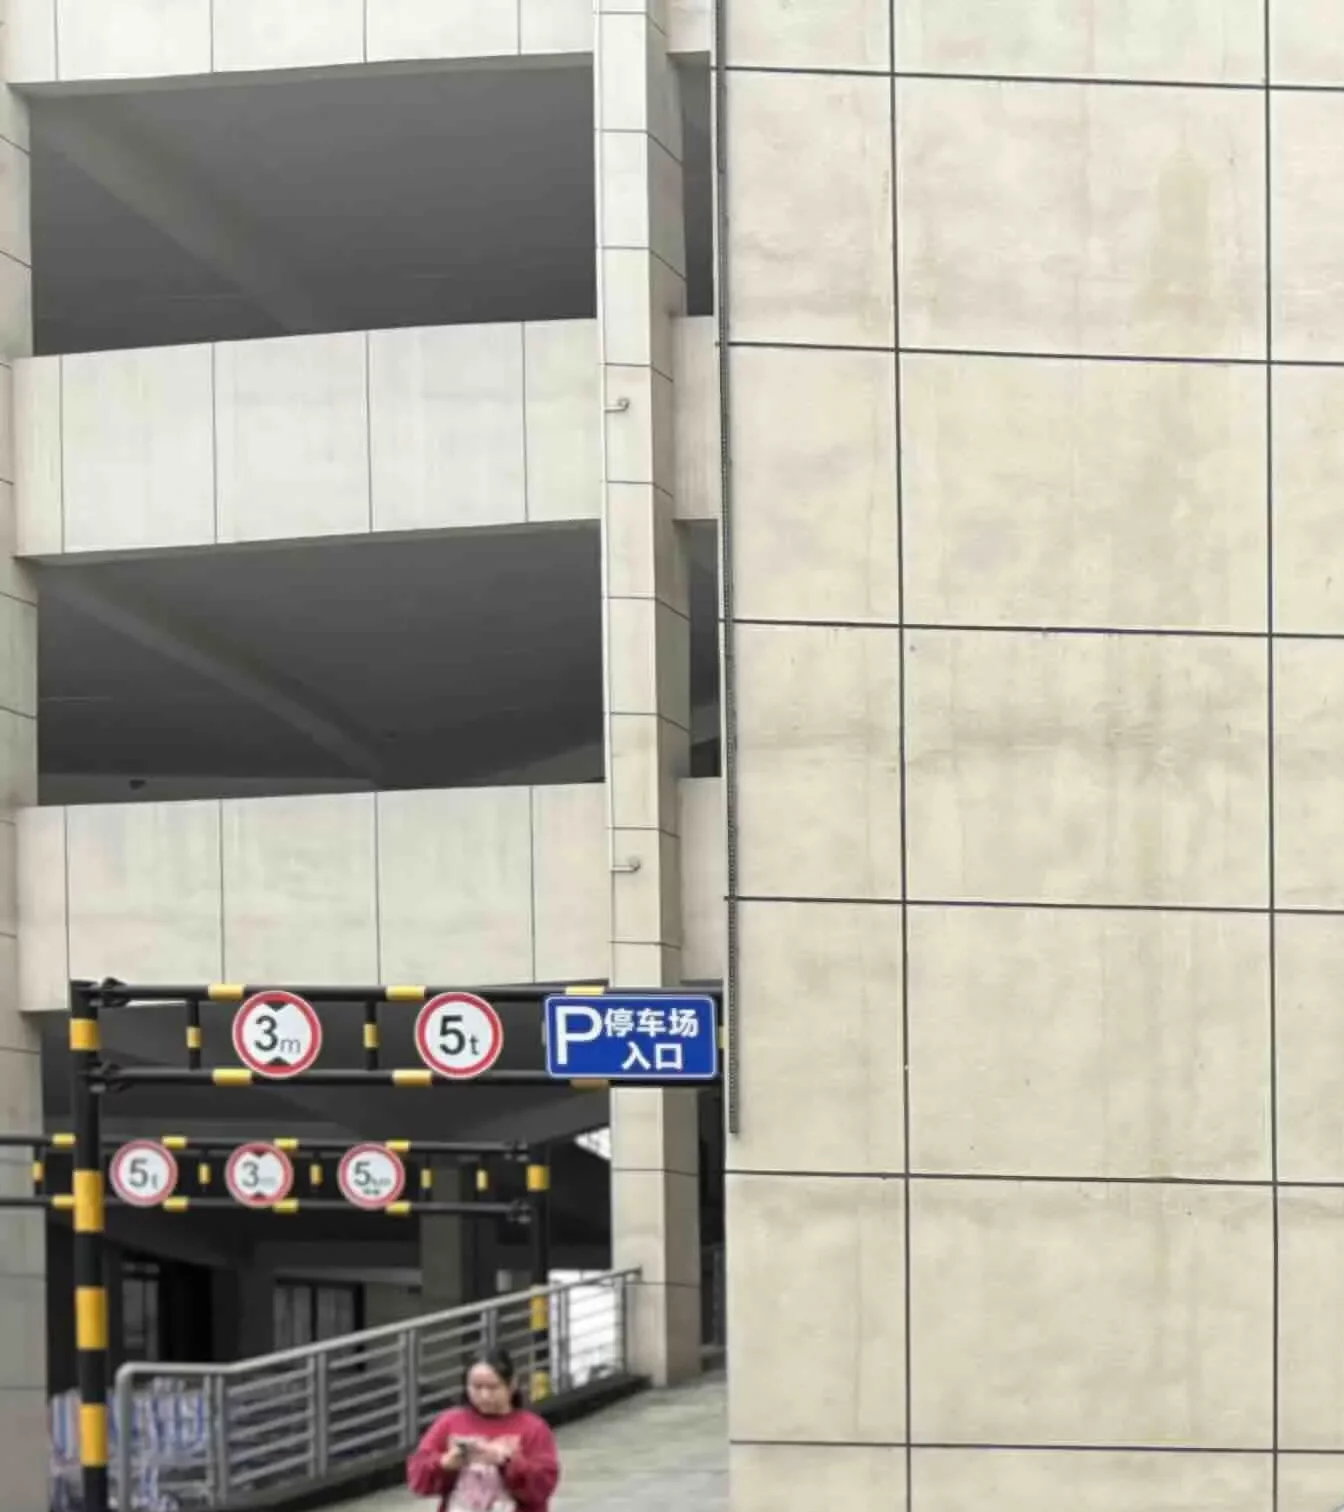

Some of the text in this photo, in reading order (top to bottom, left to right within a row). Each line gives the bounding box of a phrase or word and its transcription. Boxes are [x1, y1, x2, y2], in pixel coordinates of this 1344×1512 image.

[253, 1014, 302, 1055] 3m
[439, 1014, 480, 1056] 5t
[555, 1005, 699, 1065] P 停车场
[621, 1041, 683, 1071] 入口
